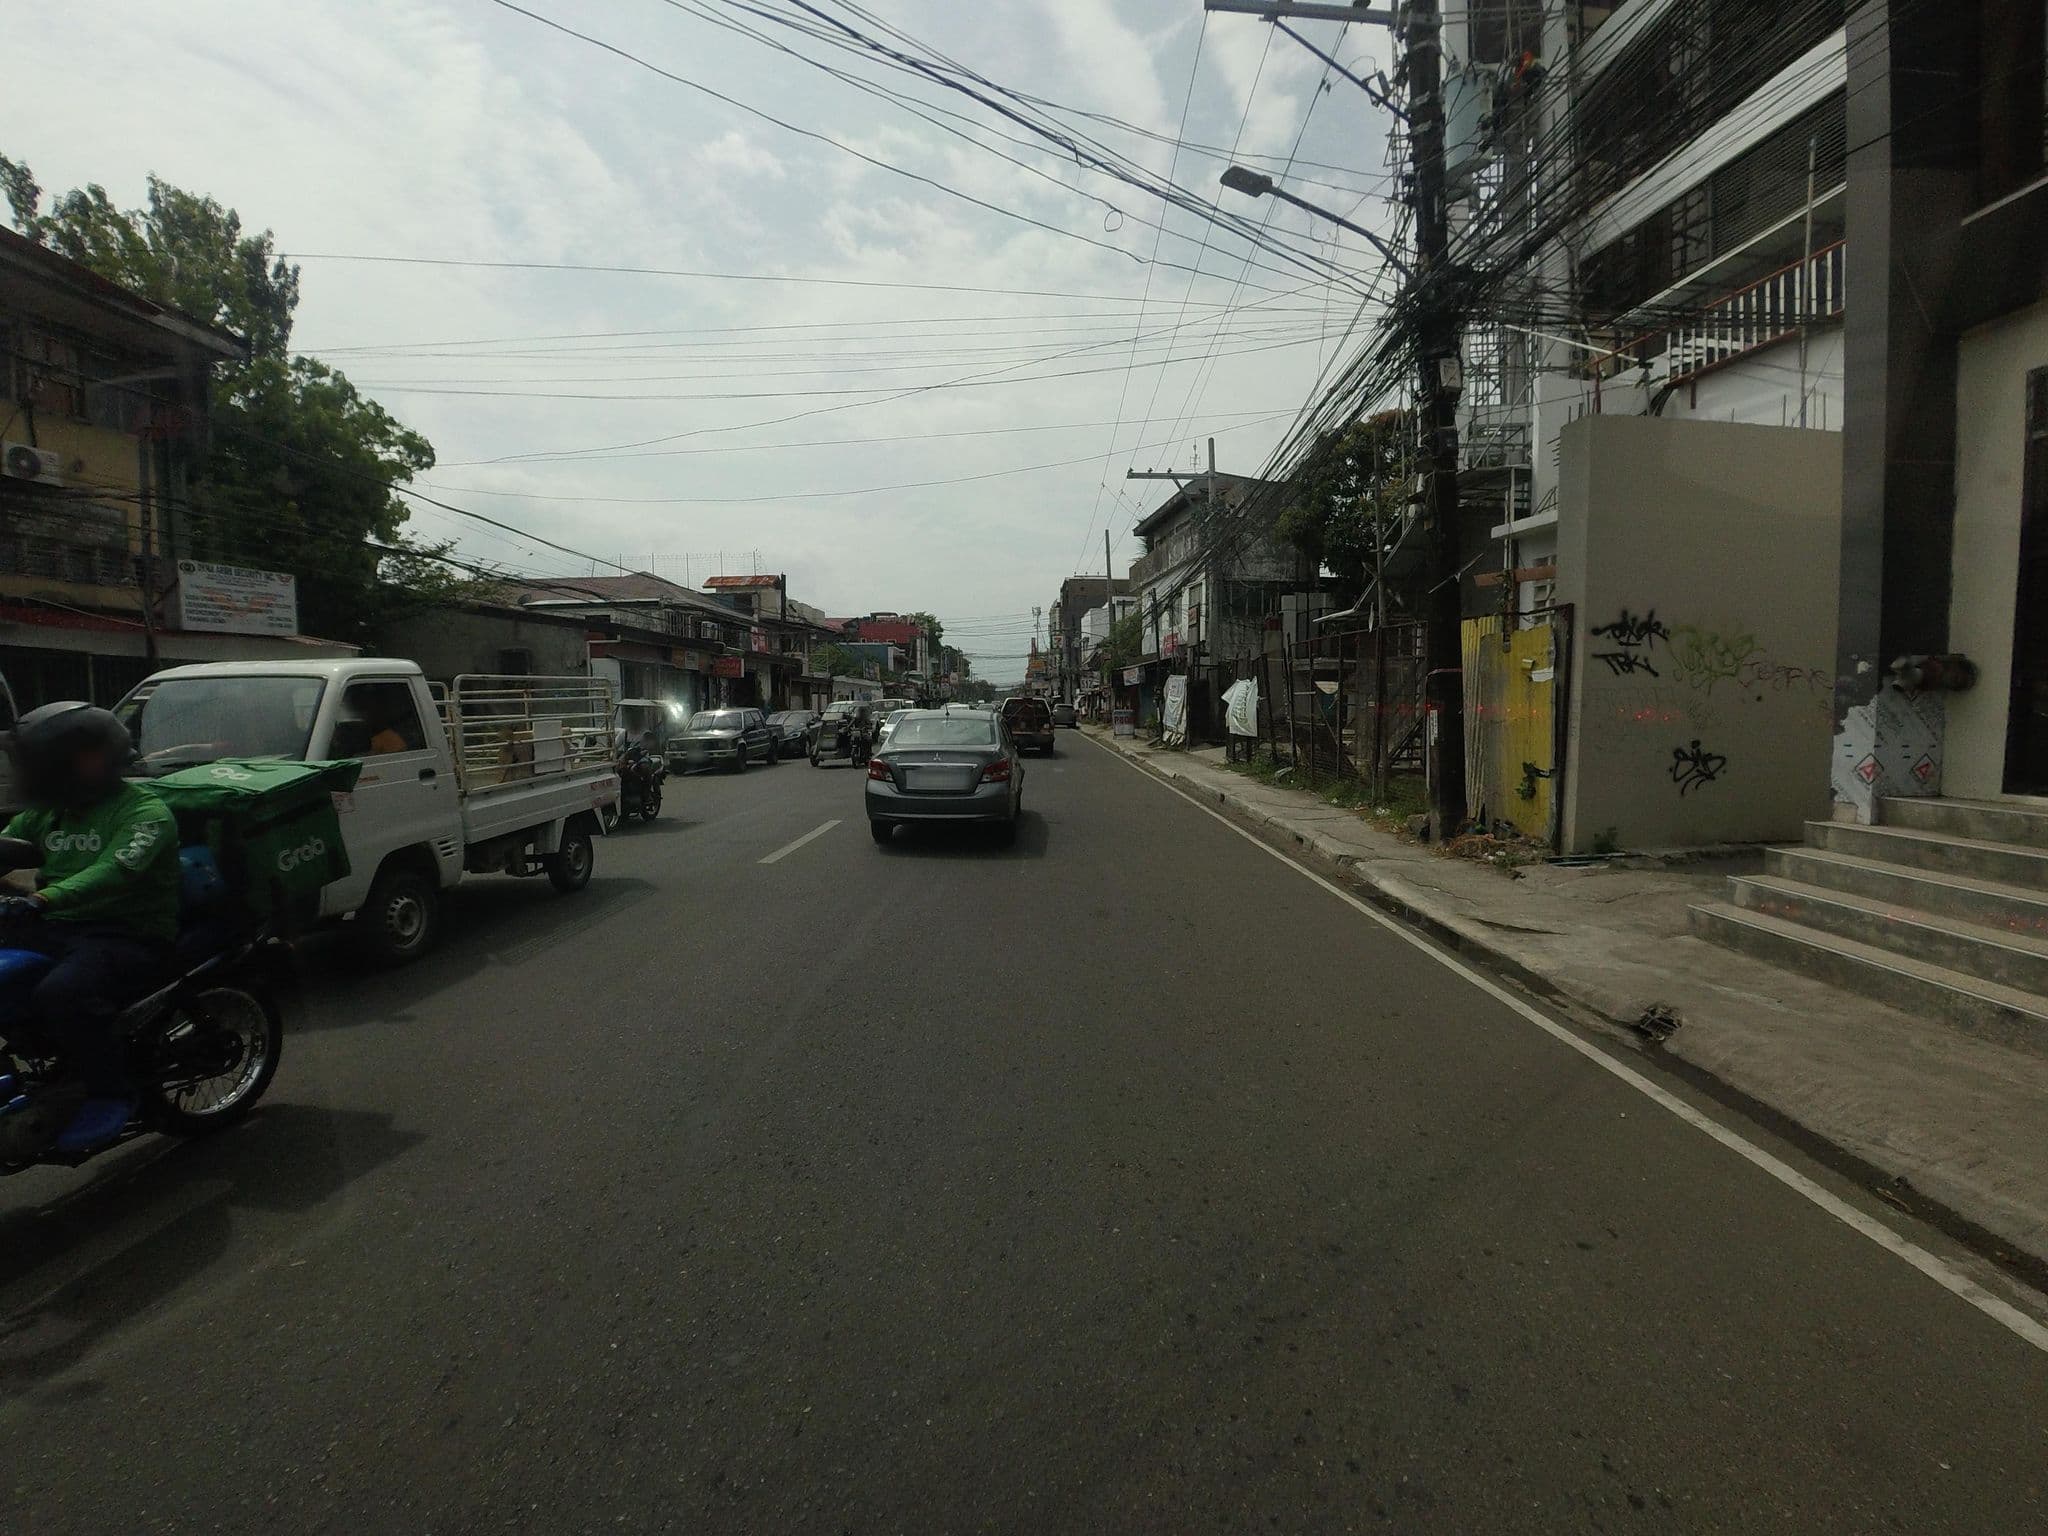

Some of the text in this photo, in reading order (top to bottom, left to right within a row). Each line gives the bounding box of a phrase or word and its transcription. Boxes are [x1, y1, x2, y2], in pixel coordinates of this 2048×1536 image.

[45, 829, 101, 852] Grab
[114, 821, 160, 870] Grab
[277, 836, 325, 872] Grab
